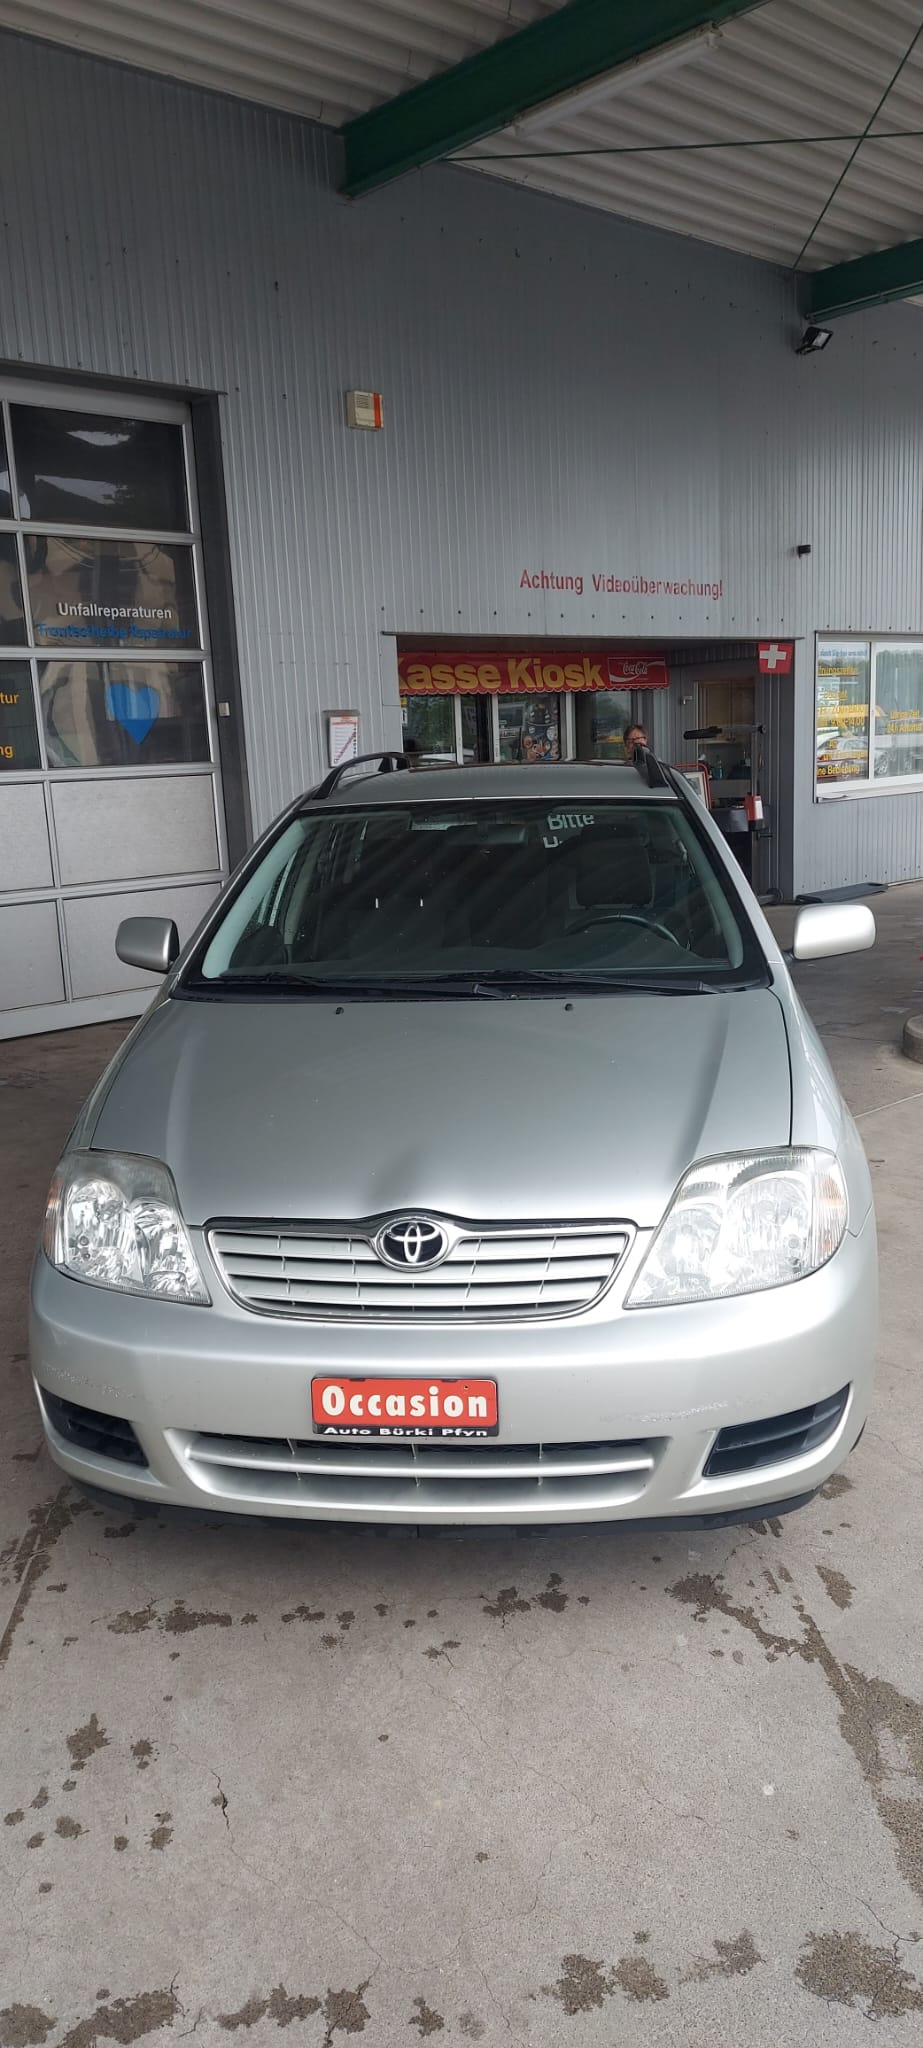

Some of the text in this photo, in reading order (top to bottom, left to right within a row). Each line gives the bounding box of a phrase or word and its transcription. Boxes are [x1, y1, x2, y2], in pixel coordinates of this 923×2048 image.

[520, 569, 723, 600] Achtung Videoüberwachung!
[58, 603, 172, 620] Unfallreparaturen
[507, 657, 605, 689] Kiosk
[322, 1385, 487, 1417] Occasion
[323, 1426, 488, 1437] Auto Bürki Pfyn
